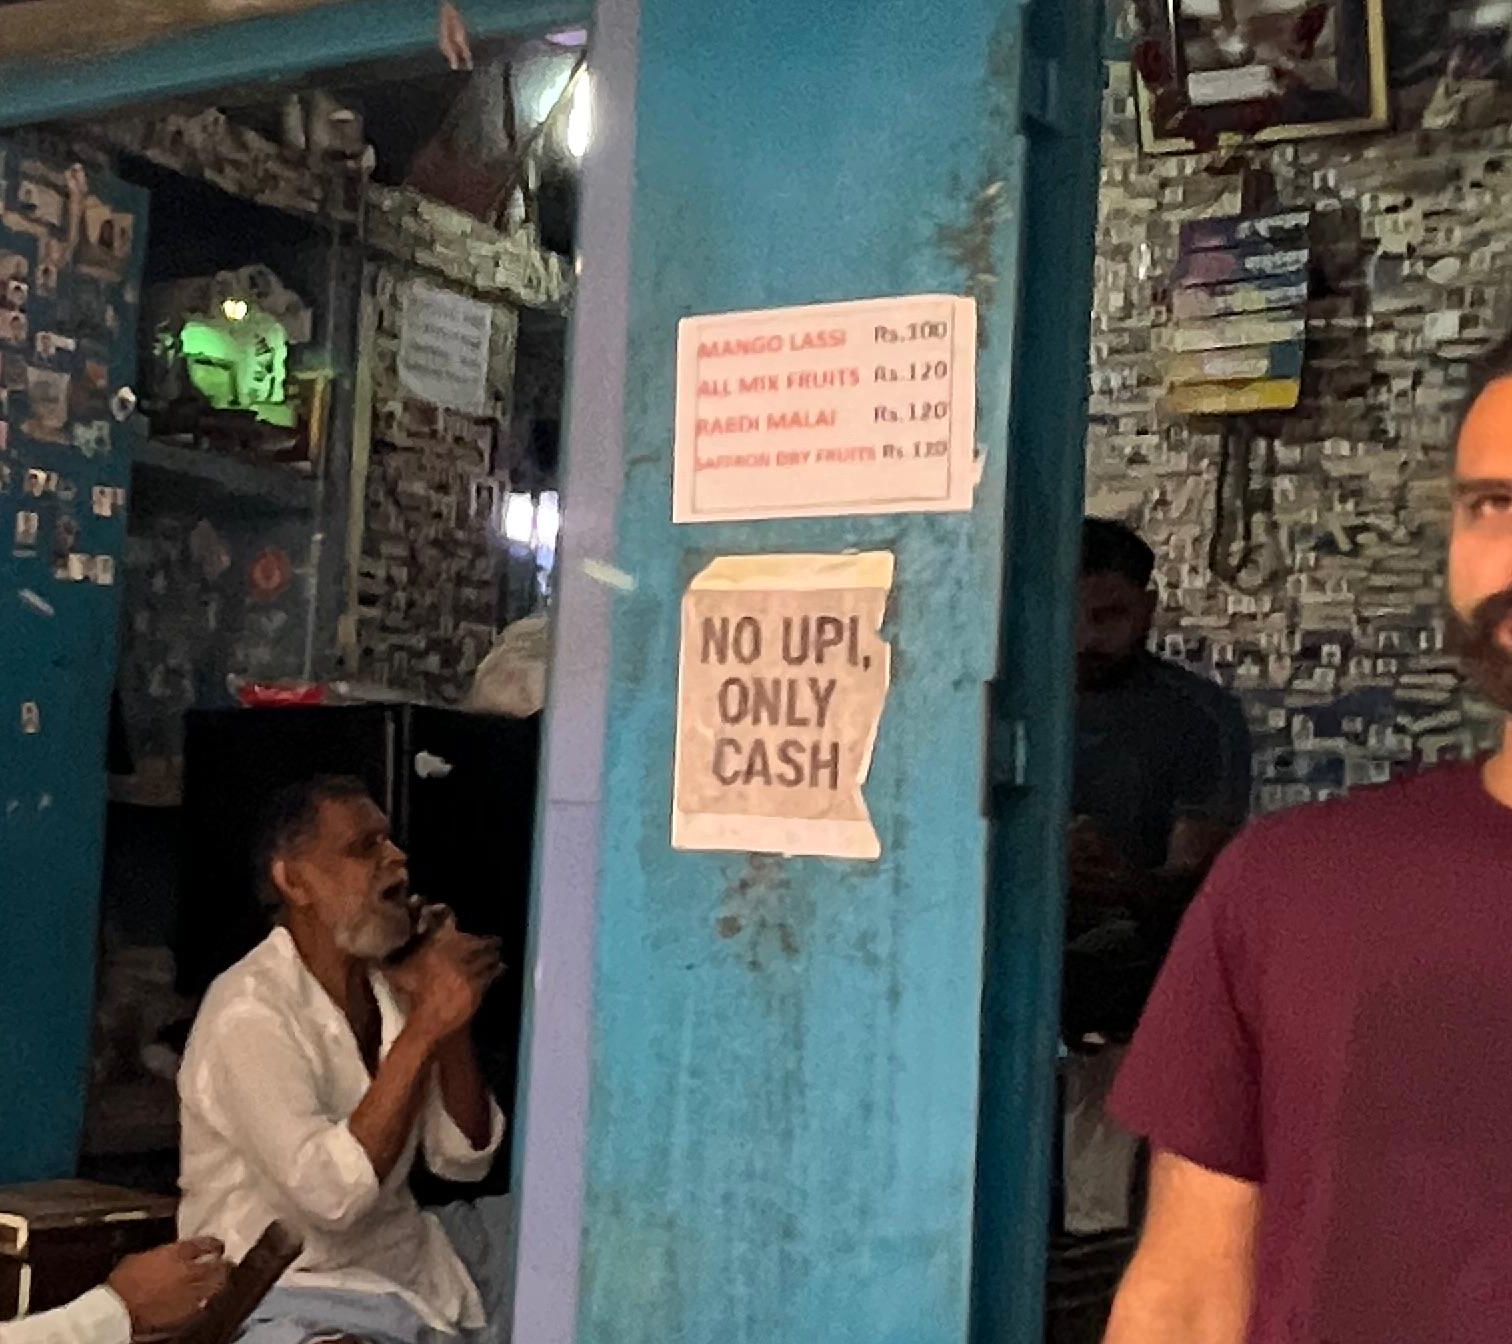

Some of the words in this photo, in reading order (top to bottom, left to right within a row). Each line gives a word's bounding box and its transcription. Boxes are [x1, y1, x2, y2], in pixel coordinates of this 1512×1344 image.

[698, 334, 783, 358] MANGO
[790, 329, 847, 351] LASSI
[786, 366, 860, 390] FRUITS
[700, 616, 762, 666] NO
[782, 615, 871, 672] UPI,
[718, 676, 837, 728] ONLY
[712, 737, 839, 791] CASH
